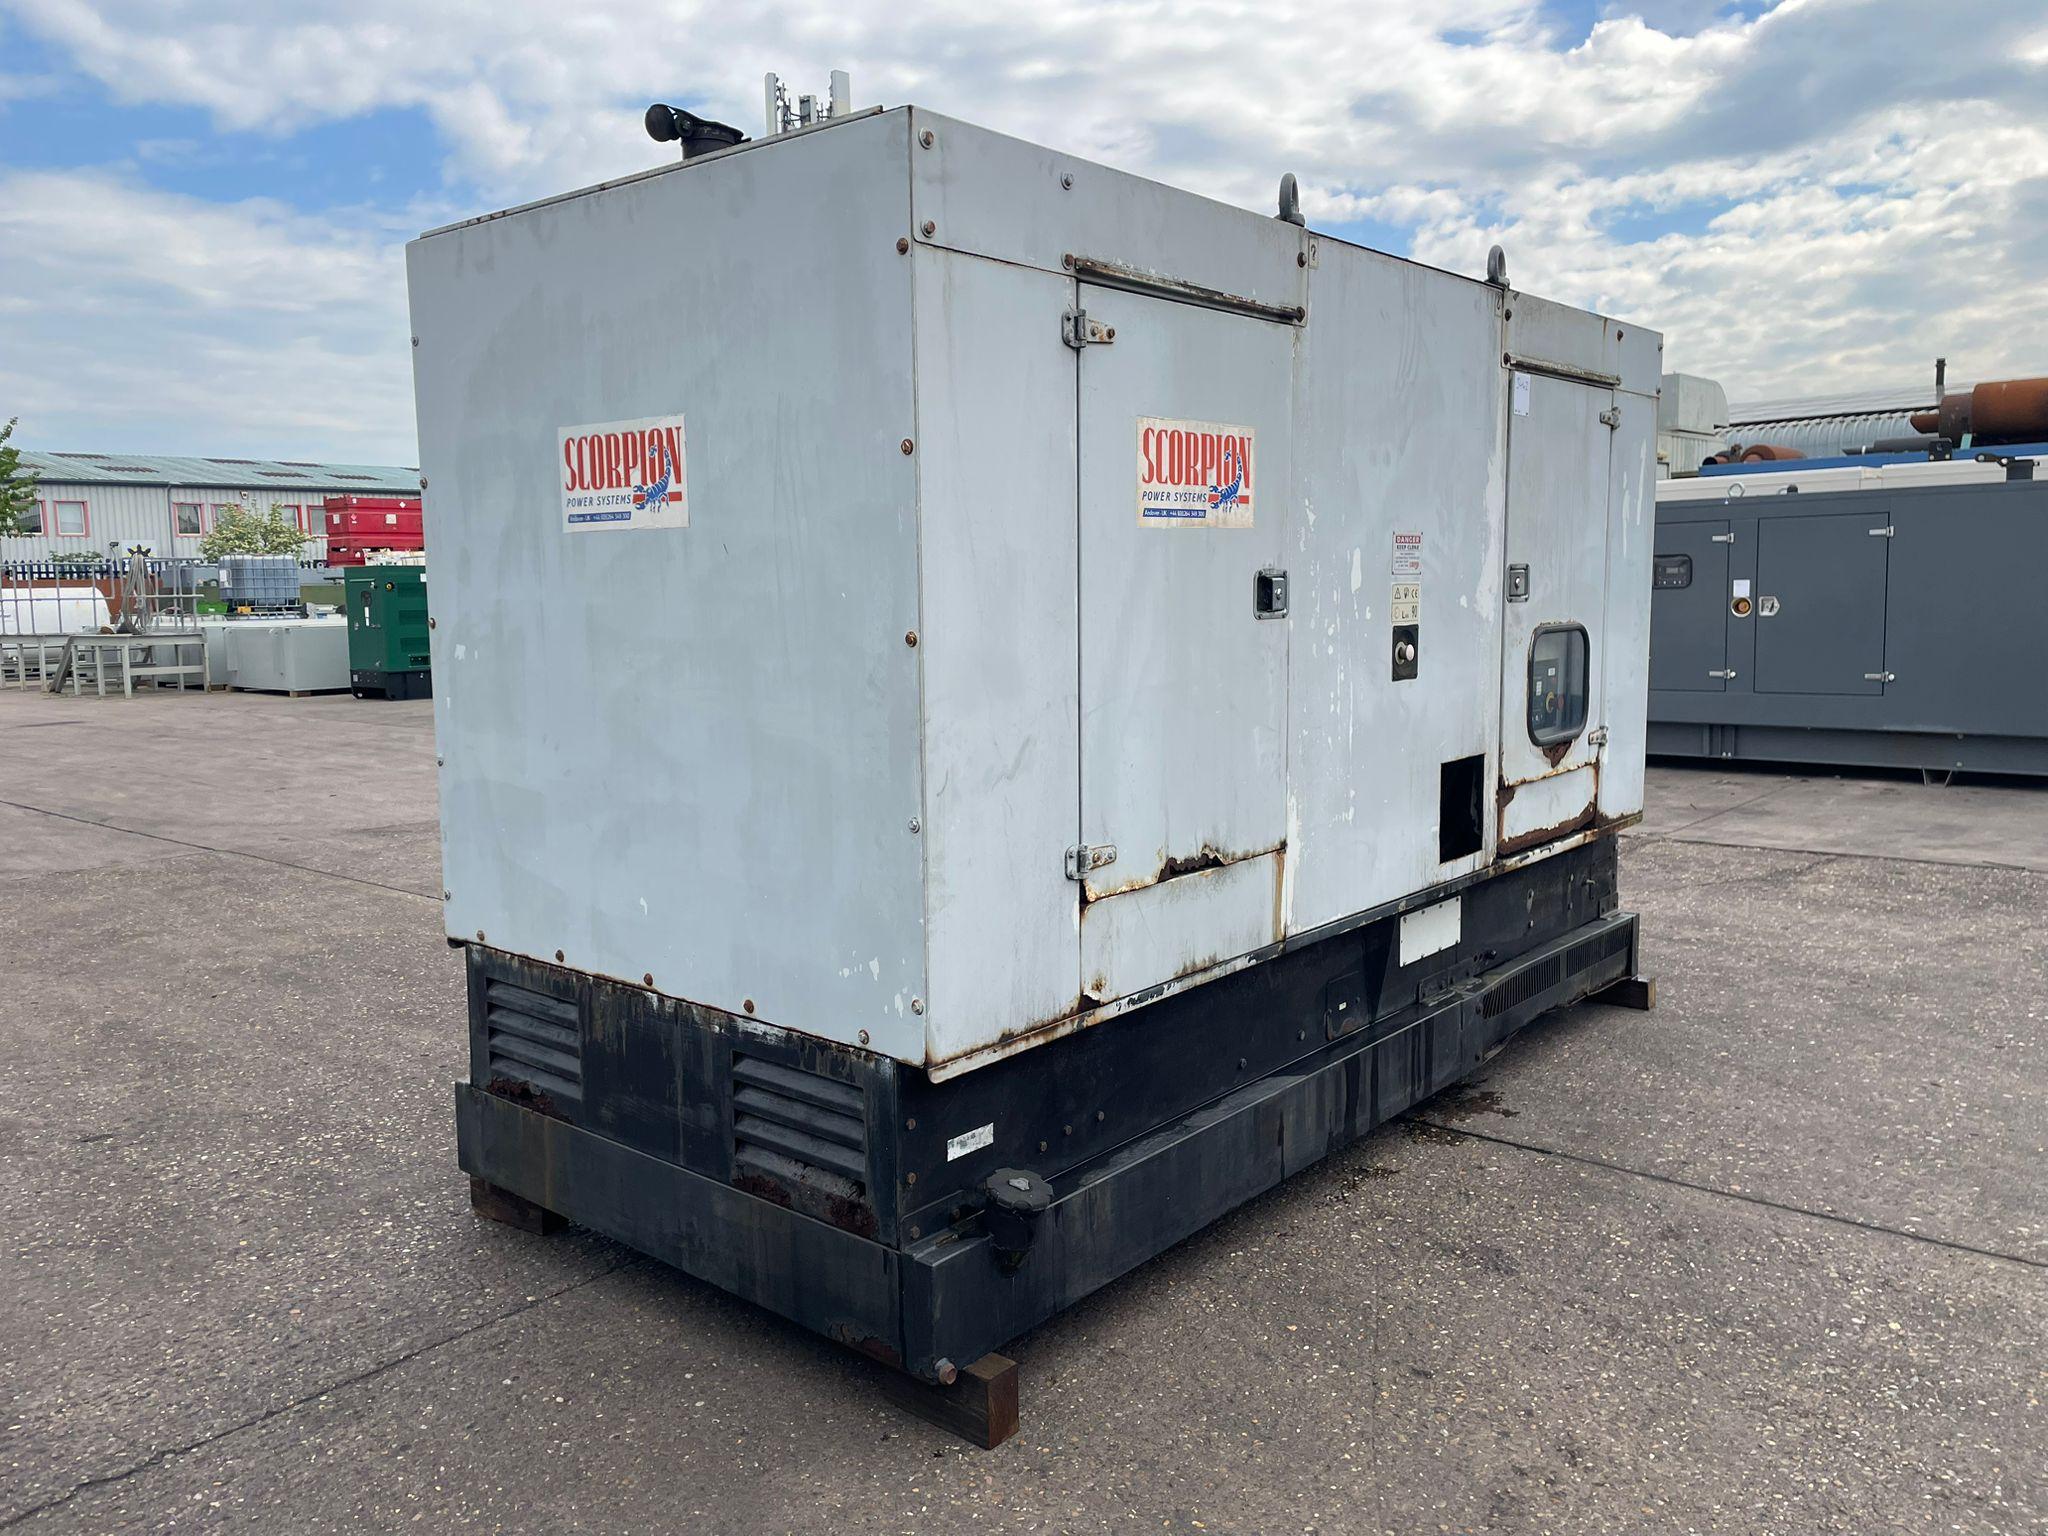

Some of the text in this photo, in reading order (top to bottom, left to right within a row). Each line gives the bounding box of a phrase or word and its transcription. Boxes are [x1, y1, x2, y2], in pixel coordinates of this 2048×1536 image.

[564, 426, 682, 492] SCORPION
[1142, 427, 1252, 489] SCORPION
[566, 494, 631, 508] POWER SYSTEMS
[1142, 491, 1207, 503] POWER SYSTEMS
[1396, 536, 1420, 544] DANGER
